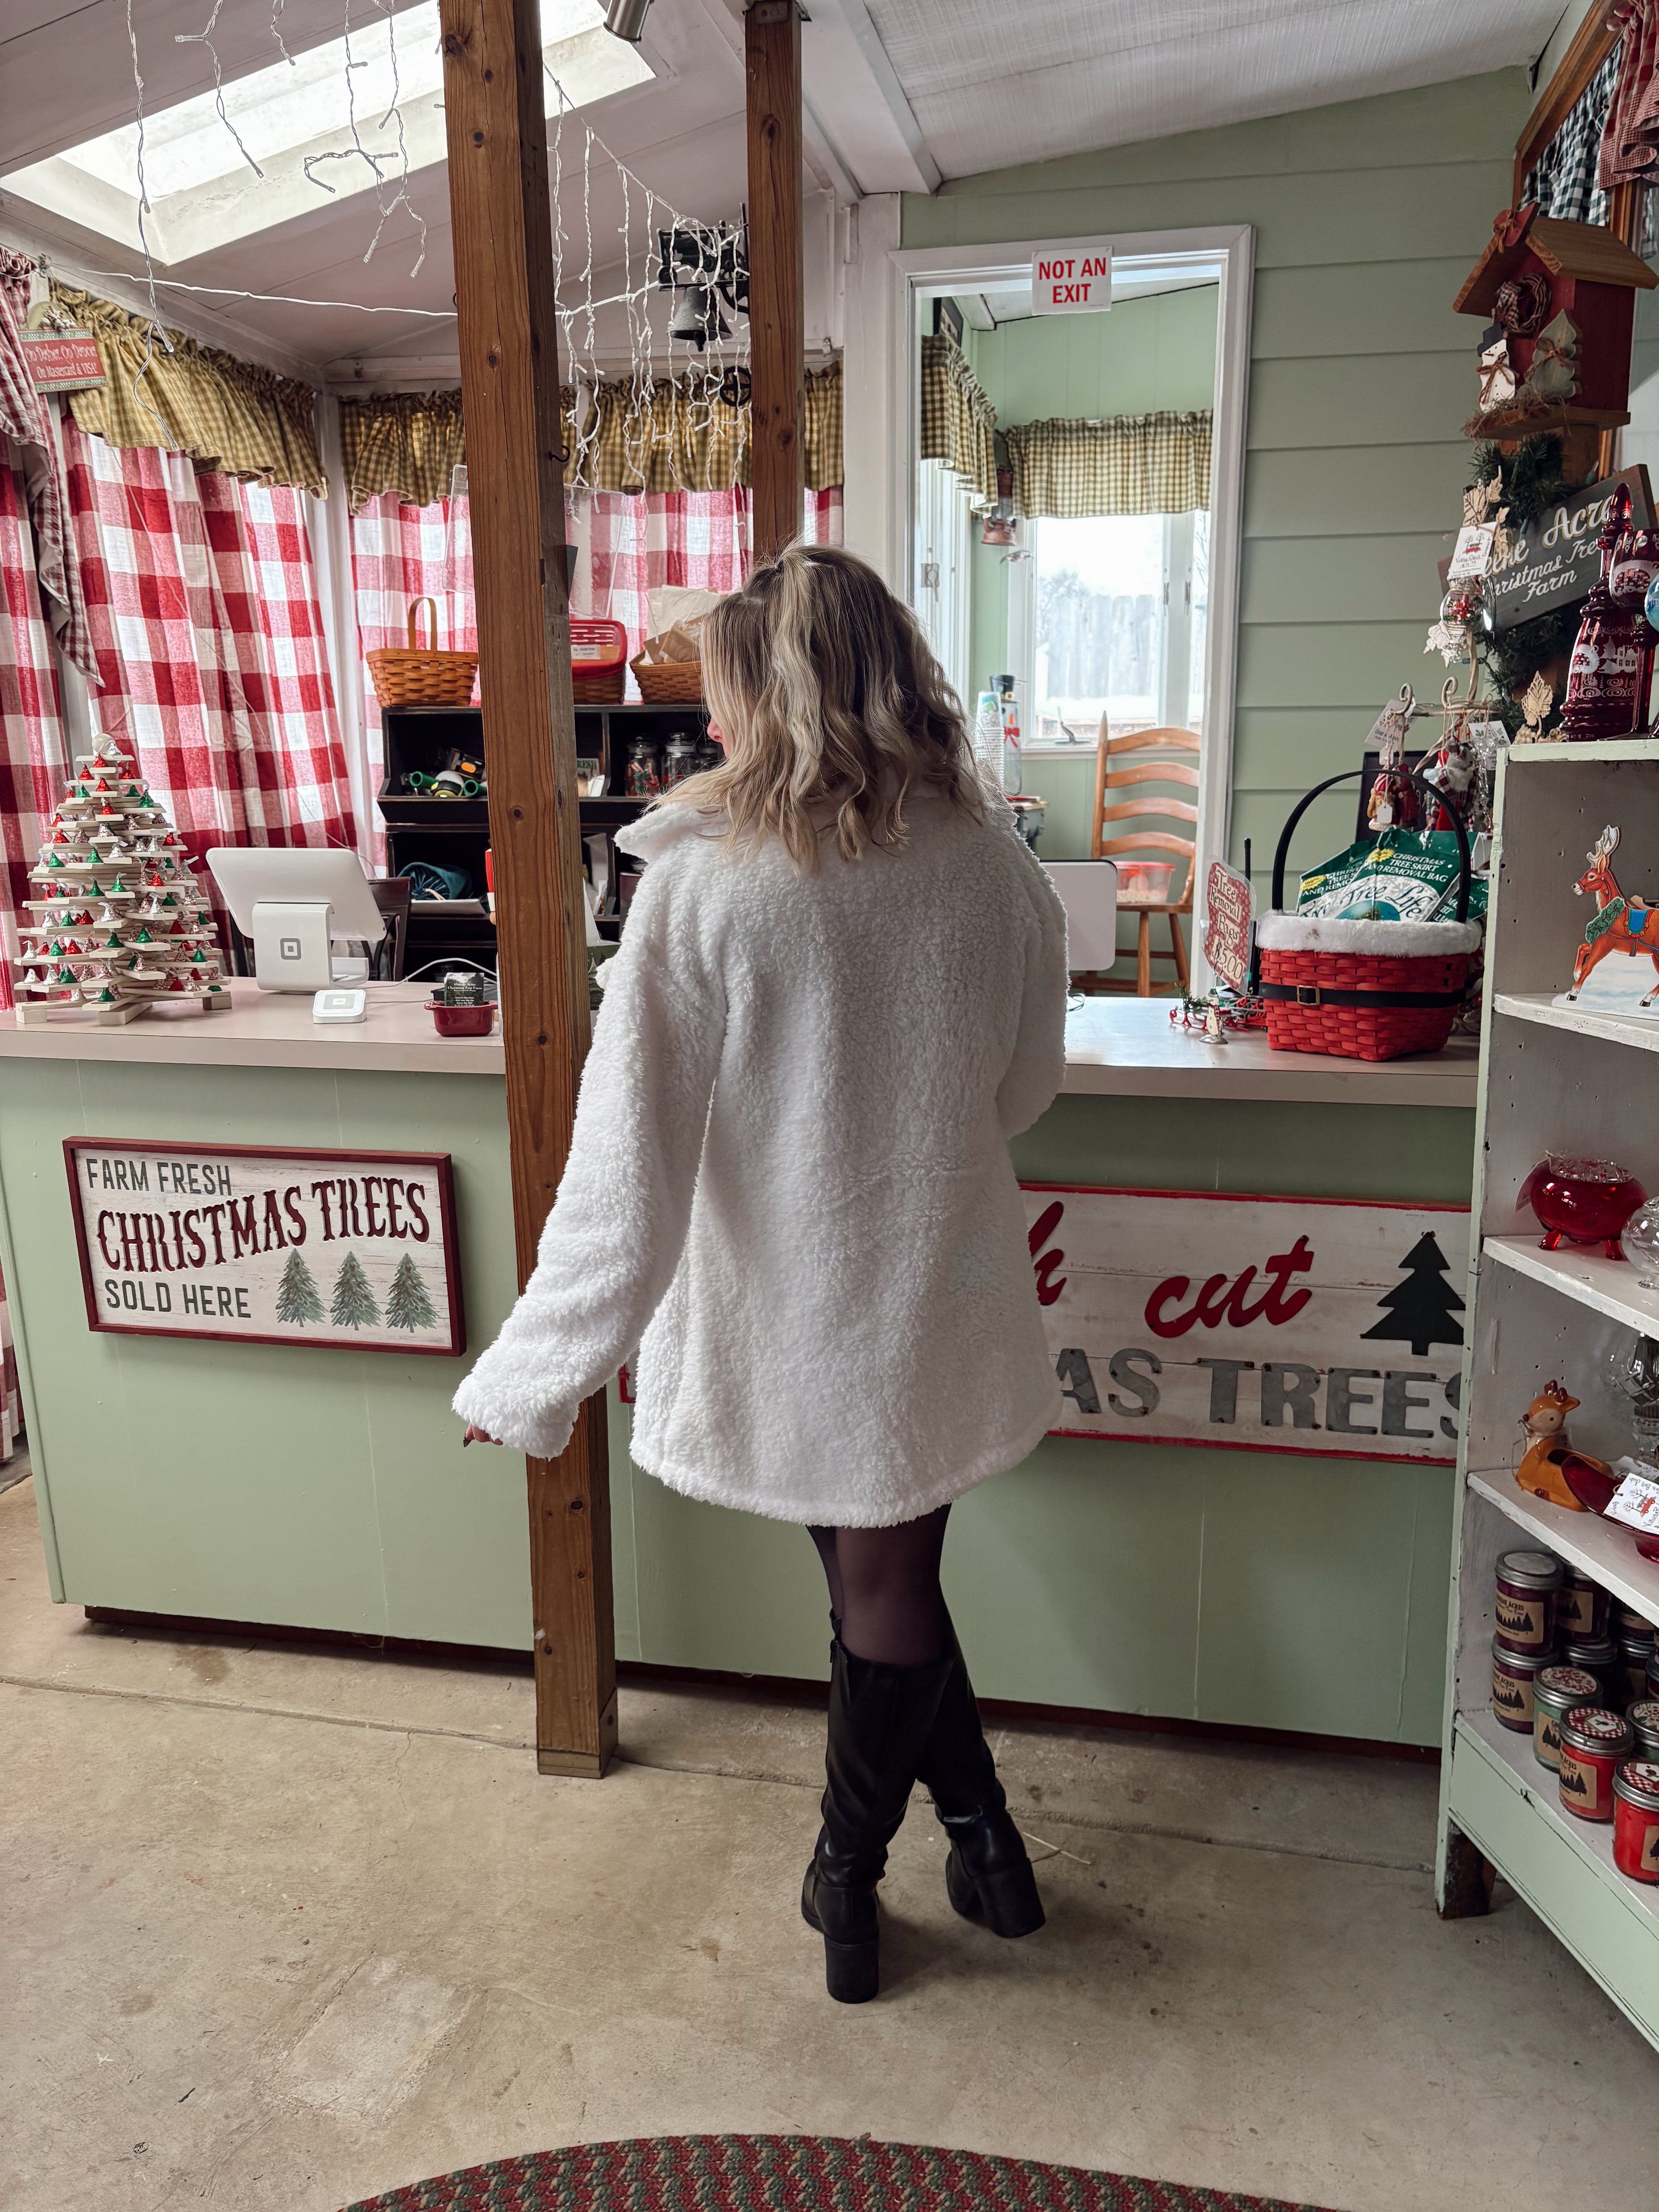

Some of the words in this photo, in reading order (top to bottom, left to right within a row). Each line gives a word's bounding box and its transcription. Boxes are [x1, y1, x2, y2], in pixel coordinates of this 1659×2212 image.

[1039, 260, 1075, 280] NOT
[1081, 257, 1106, 277] AN
[1052, 283, 1091, 303] EXIT
[1522, 569, 1577, 603] Farm
[1382, 865, 1427, 879] REMOVAL
[1427, 873, 1449, 882] BAG
[1389, 859, 1412, 869] TREE
[1410, 863, 1439, 873] SKIRT
[1392, 852, 1446, 865] CHRISTMAS
[1216, 869, 1236, 899] Tree
[1302, 887, 1325, 896] AND
[1340, 877, 1387, 908] Tree
[1384, 886, 1433, 918] Life
[1210, 884, 1240, 920] Removal
[1218, 914, 1239, 946] Bags
[1212, 938, 1243, 980] $5.00
[86, 1159, 149, 1192] FARM
[157, 1162, 232, 1196] FRESH
[97, 1185, 307, 1273] CHRISTMAS
[311, 1176, 429, 1243] TREES
[105, 1279, 172, 1312] SOLD
[183, 1284, 251, 1318] HERE
[1145, 1235, 1314, 1338] cut
